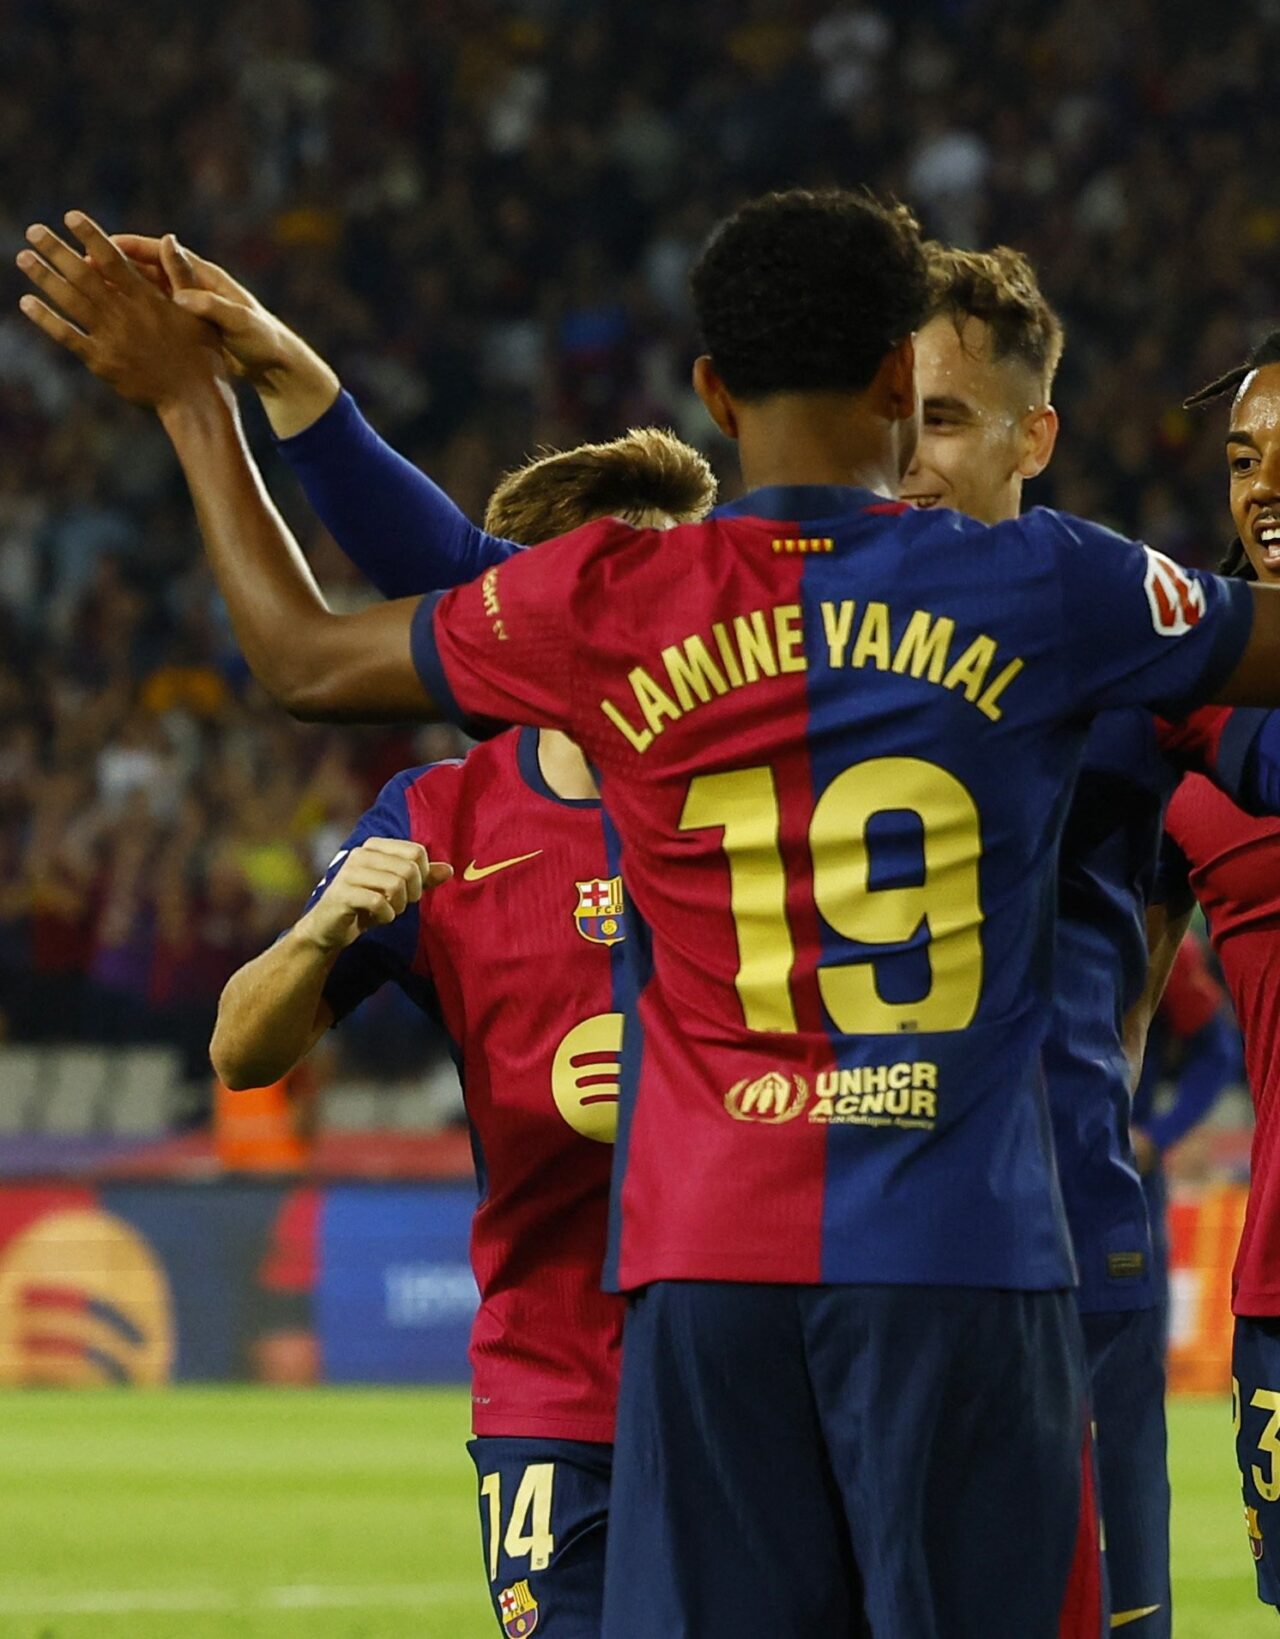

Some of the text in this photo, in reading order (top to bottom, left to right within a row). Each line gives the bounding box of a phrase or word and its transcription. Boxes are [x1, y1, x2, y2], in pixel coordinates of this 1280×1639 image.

[600, 600, 1024, 754] LAMINE YAMAL
[596, 905, 622, 915] FCB
[678, 756, 985, 1034] 19
[808, 1089, 937, 1117] ACNUR
[815, 1061, 938, 1097] UNHCR
[481, 1463, 555, 1583] 14
